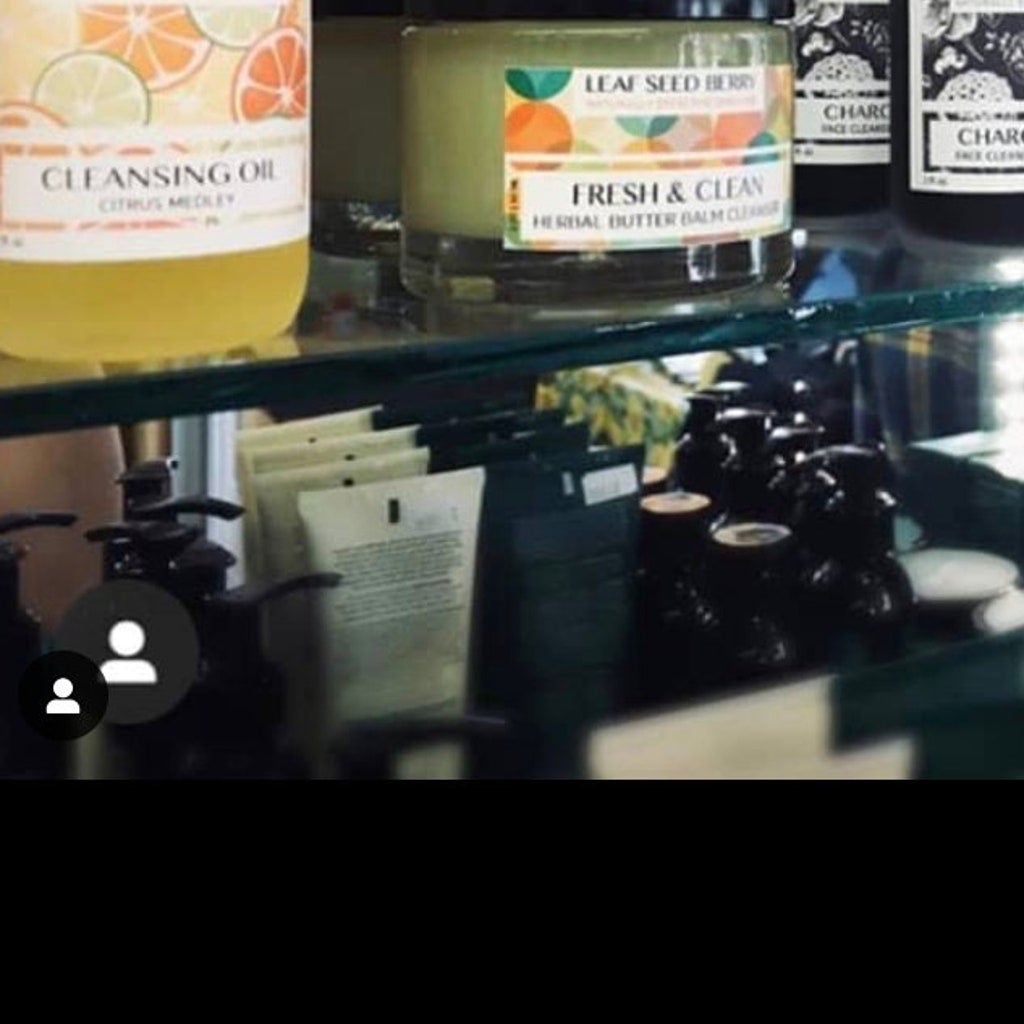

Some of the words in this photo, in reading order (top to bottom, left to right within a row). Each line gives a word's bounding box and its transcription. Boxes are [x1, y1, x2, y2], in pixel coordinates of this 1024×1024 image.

[585, 74, 636, 94] LEAF
[645, 74, 700, 94] SEED
[705, 73, 756, 93] BERRY
[40, 164, 232, 193] CLEANSING
[239, 159, 276, 183] OIL
[572, 183, 659, 207] FRESH
[666, 181, 686, 204] &
[694, 175, 765, 202] CLEAN
[98, 196, 163, 214] CITRUS
[168, 193, 236, 211] MEDLEY
[533, 213, 600, 230] HERBAL
[608, 211, 677, 229] BUTTER
[680, 208, 725, 226] BALM
